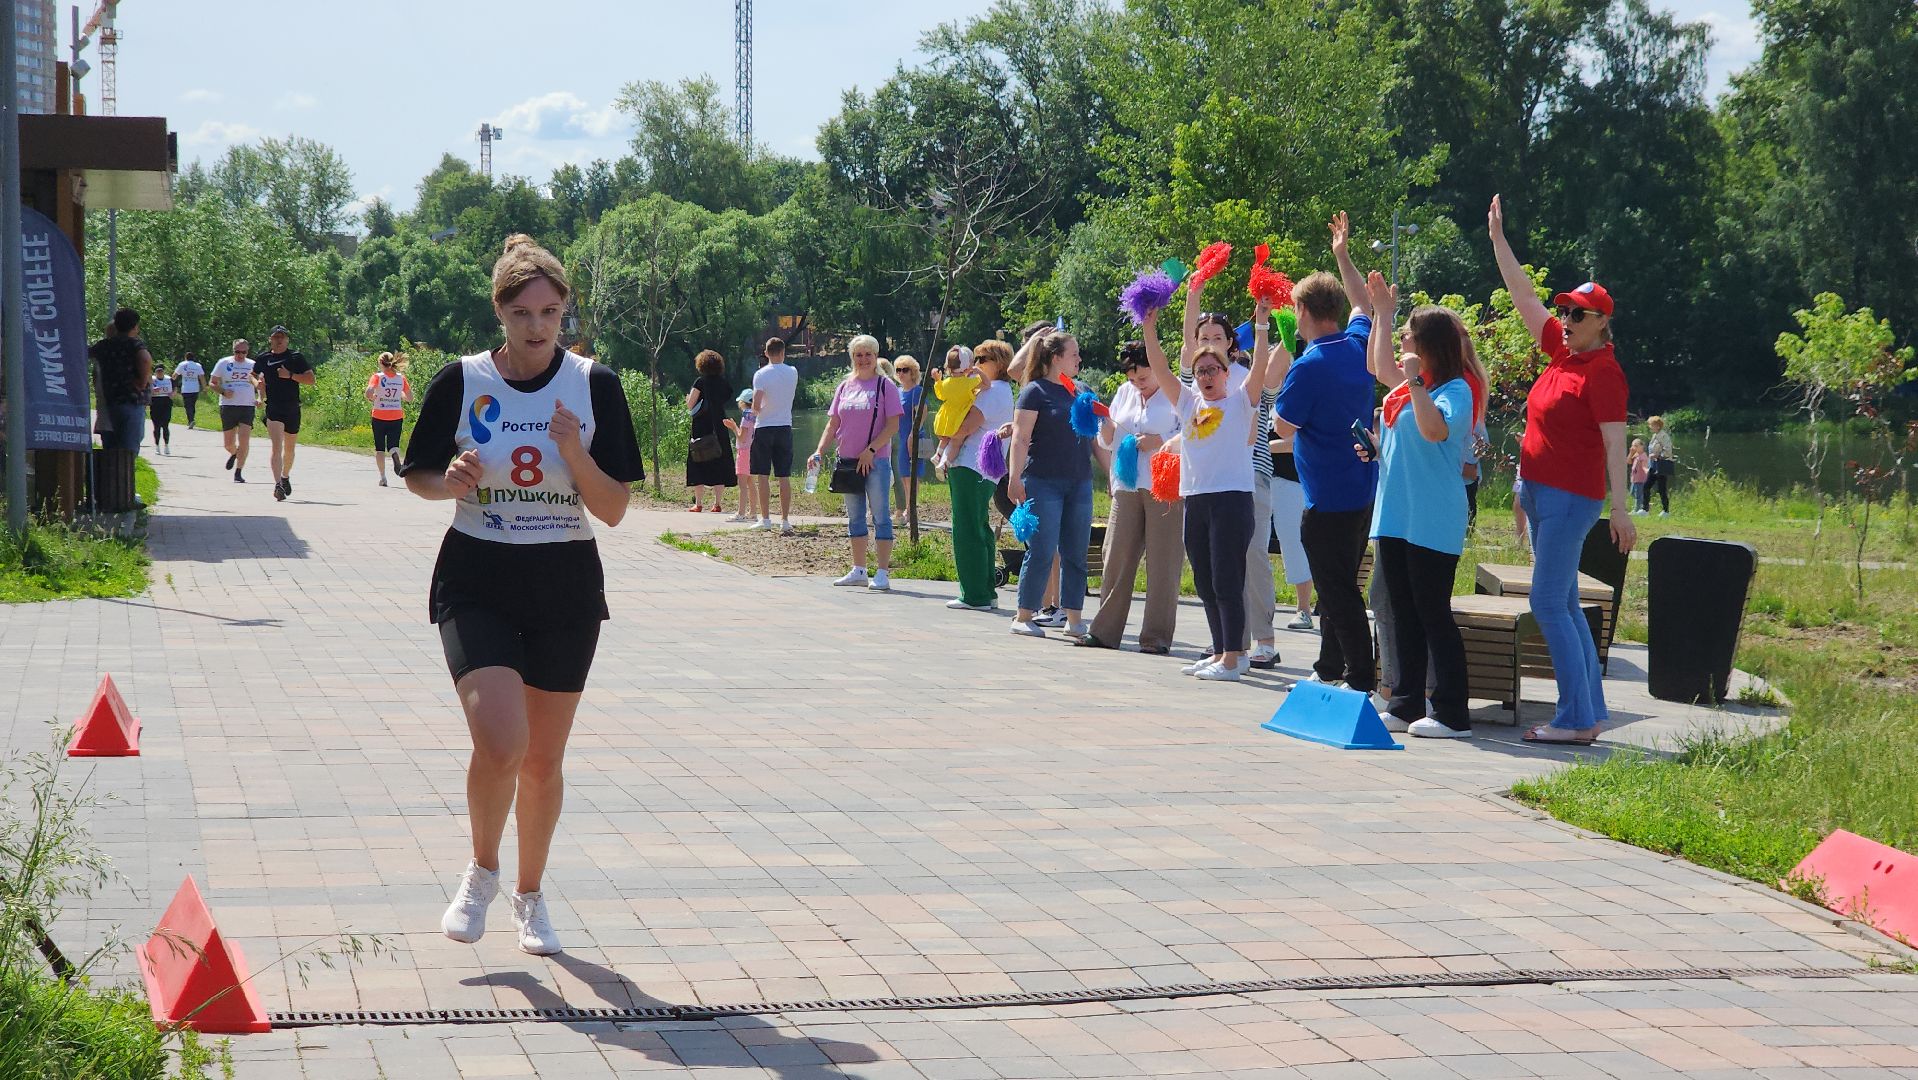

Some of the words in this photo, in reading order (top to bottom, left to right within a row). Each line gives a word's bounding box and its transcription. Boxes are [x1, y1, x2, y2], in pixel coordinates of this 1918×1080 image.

[231, 372, 248, 380] 52
[384, 388, 398, 398] 37
[502, 421, 586, 432] Ростелм
[511, 446, 543, 487] 8
[494, 488, 579, 506] ПУШКИНО
